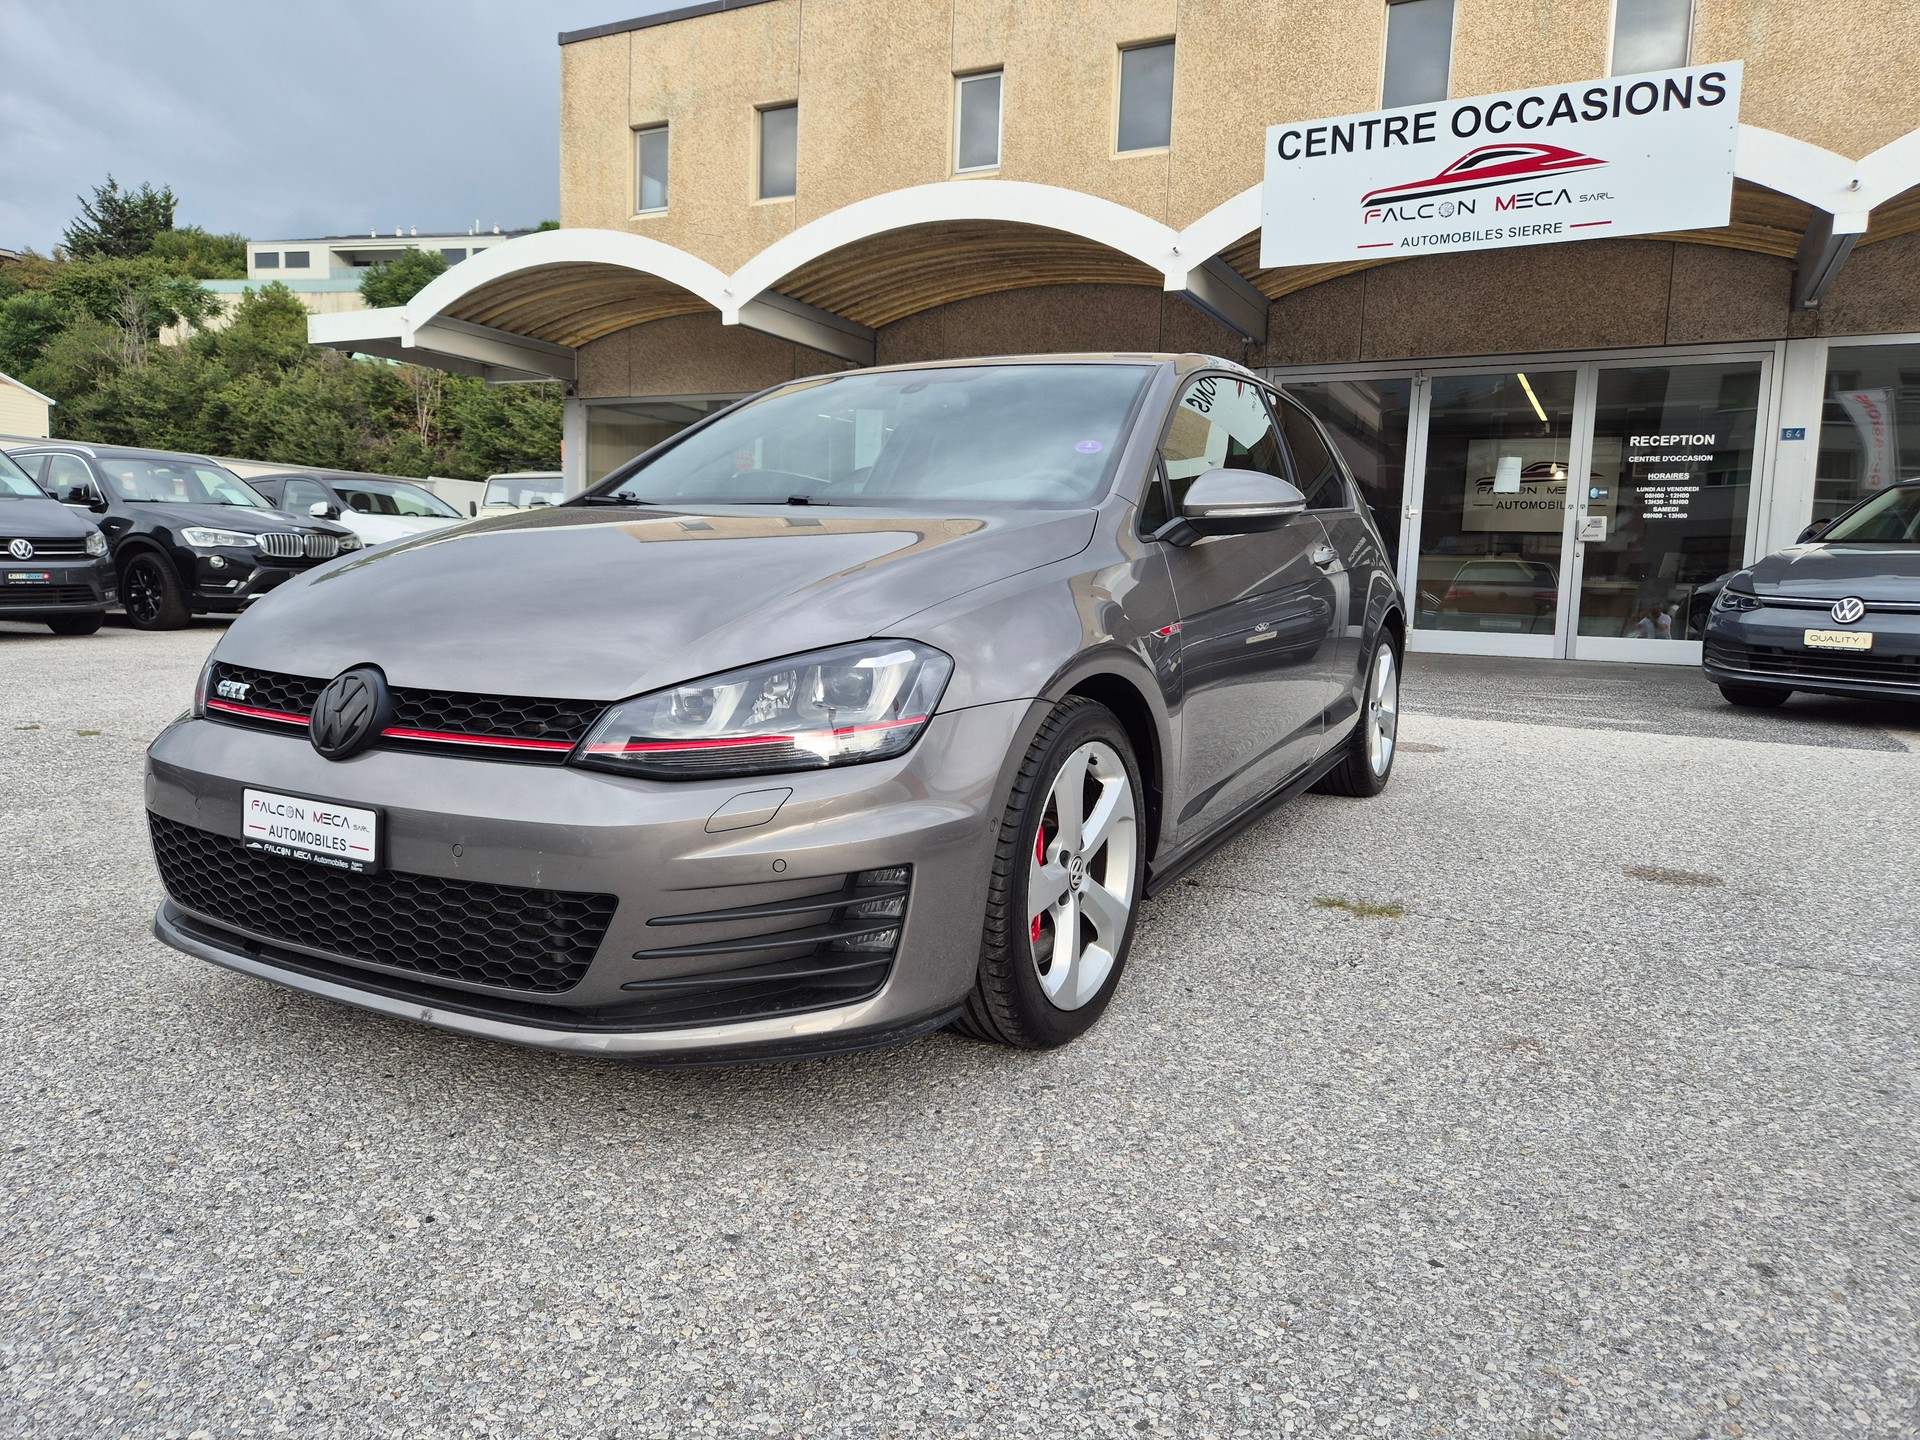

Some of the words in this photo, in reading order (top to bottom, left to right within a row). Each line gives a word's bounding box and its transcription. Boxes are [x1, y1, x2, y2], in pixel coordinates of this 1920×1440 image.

[1277, 111, 1438, 161] CENTRE
[1450, 71, 1727, 138] OCCASIONS
[1363, 198, 1476, 225] FALCON
[1494, 188, 1573, 211] MECA
[1578, 190, 1614, 203] SARL
[1400, 227, 1504, 249] AUTOMOBILES
[1507, 221, 1563, 240] SIERRE
[1629, 434, 1716, 447] RECEPTION
[1628, 455, 1661, 463] CENTRE
[1647, 472, 1690, 480] HORAIRES
[217, 679, 251, 701] GTI
[251, 799, 305, 821] FALCON
[312, 810, 350, 829] MECA
[268, 824, 347, 852] AUTOMOBILES
[263, 843, 291, 857] FALCON
[293, 849, 312, 861] MECA
[313, 854, 349, 869] Automobiles
